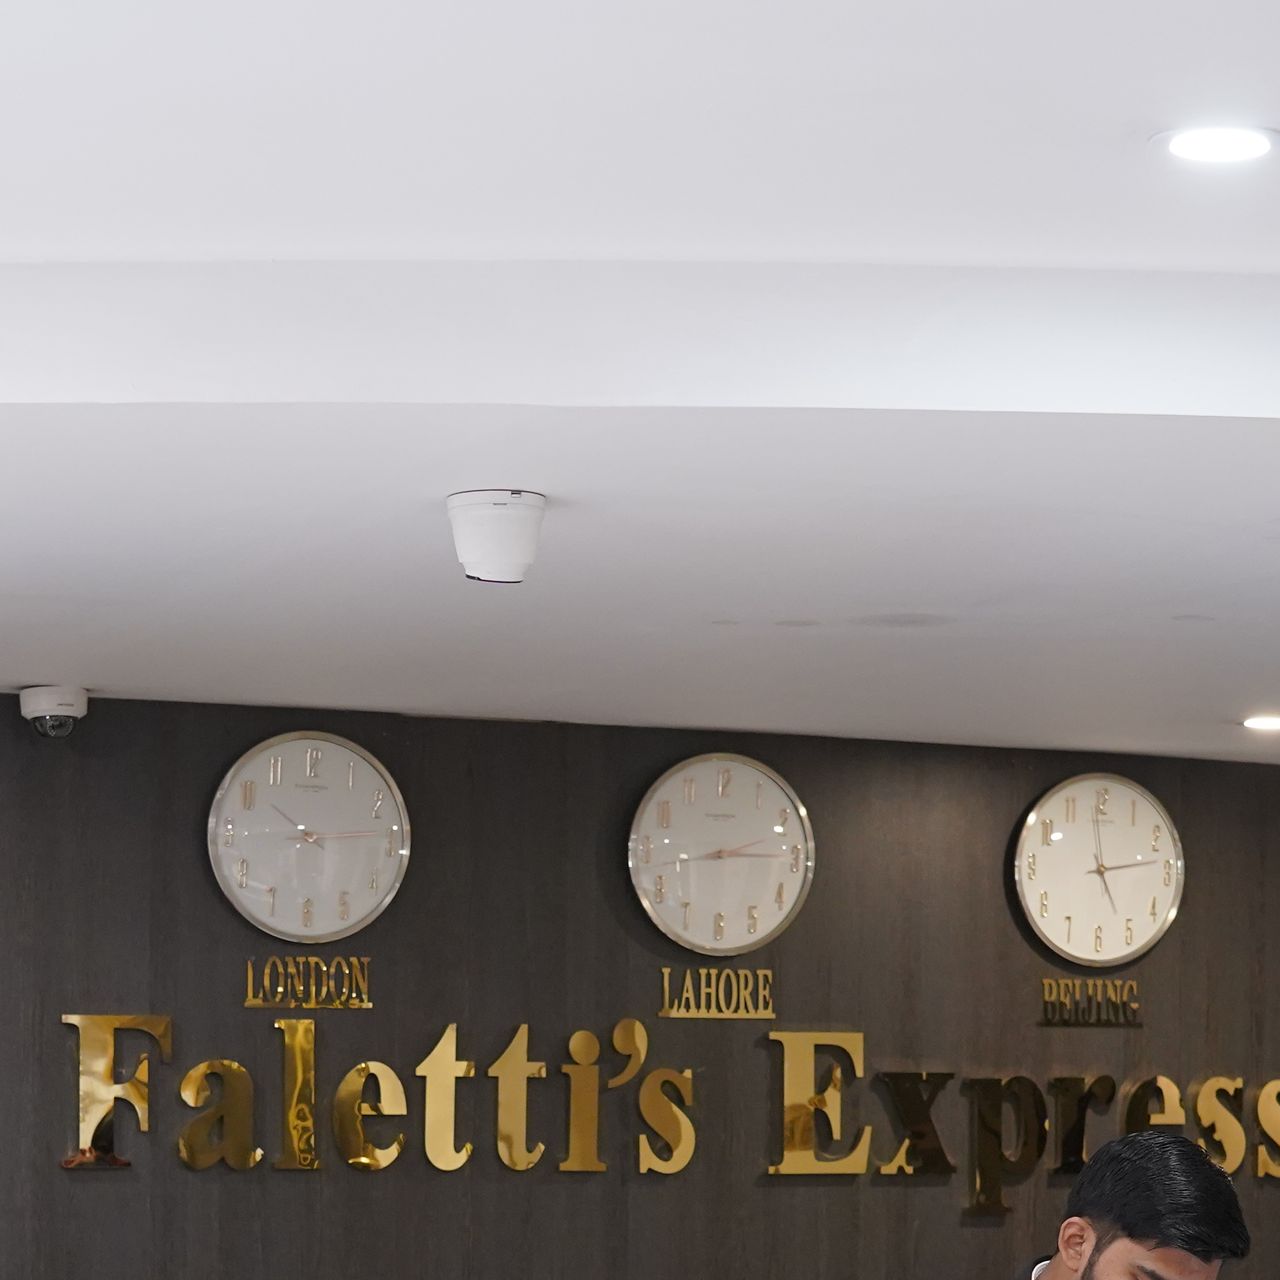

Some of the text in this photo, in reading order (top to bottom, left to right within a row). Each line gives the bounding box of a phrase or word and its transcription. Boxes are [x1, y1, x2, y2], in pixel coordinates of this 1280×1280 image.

[270, 756, 282, 785] 11
[306, 748, 322, 777] 12
[372, 790, 383, 819] 2
[1065, 797, 1076, 823] 11
[1152, 825, 1160, 852] 2
[239, 858, 247, 889] 8
[1028, 852, 1036, 880] 9
[1164, 859, 1173, 887] 3
[368, 867, 377, 895] 4
[266, 886, 275, 916] 7
[1150, 896, 1157, 923] 4
[244, 955, 373, 1008] LONDON
[658, 967, 776, 1019] LAHORE
[1037, 979, 1143, 1027] BEIJING
[60, 1013, 696, 1175] Faletti's
